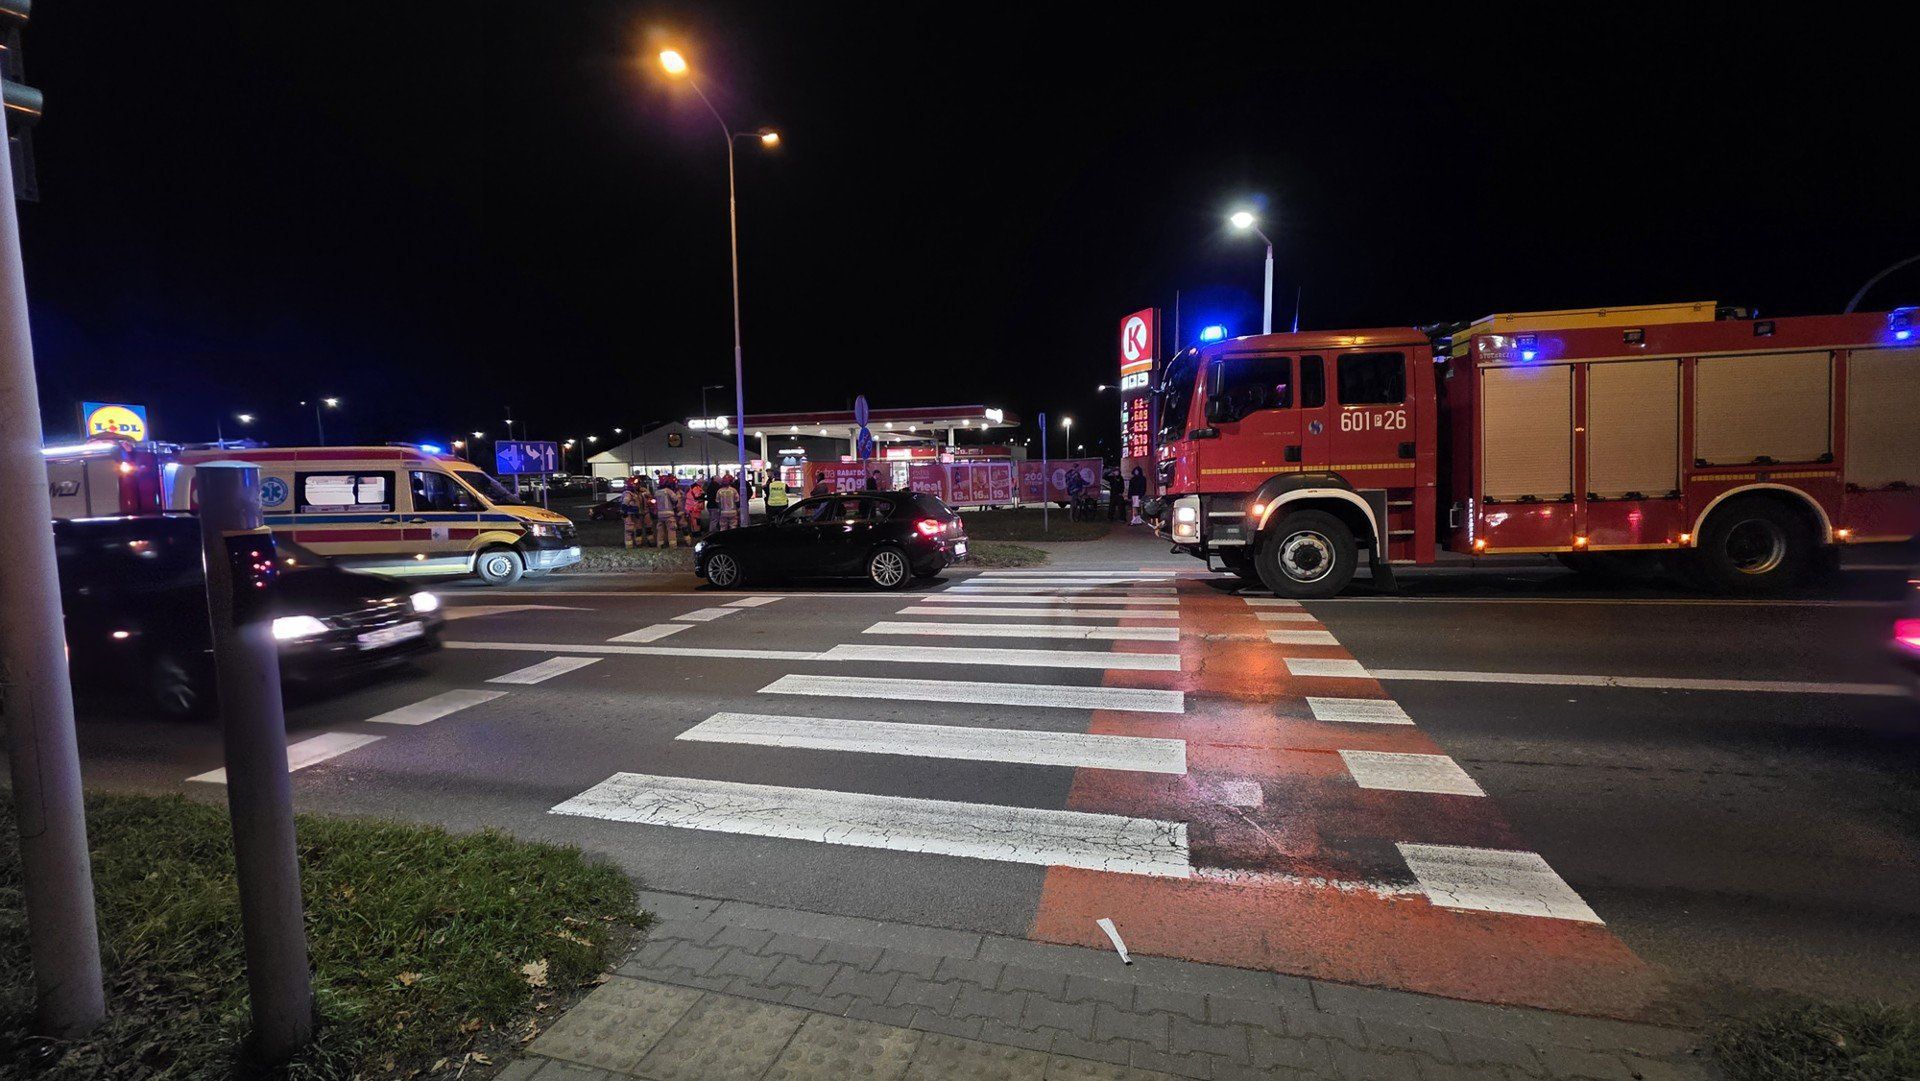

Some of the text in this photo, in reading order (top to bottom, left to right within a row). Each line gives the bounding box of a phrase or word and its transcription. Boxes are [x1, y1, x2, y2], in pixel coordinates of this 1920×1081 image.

[1340, 411, 1370, 432] 601
[1384, 410, 1407, 430] 26
[912, 480, 942, 492] Meal
